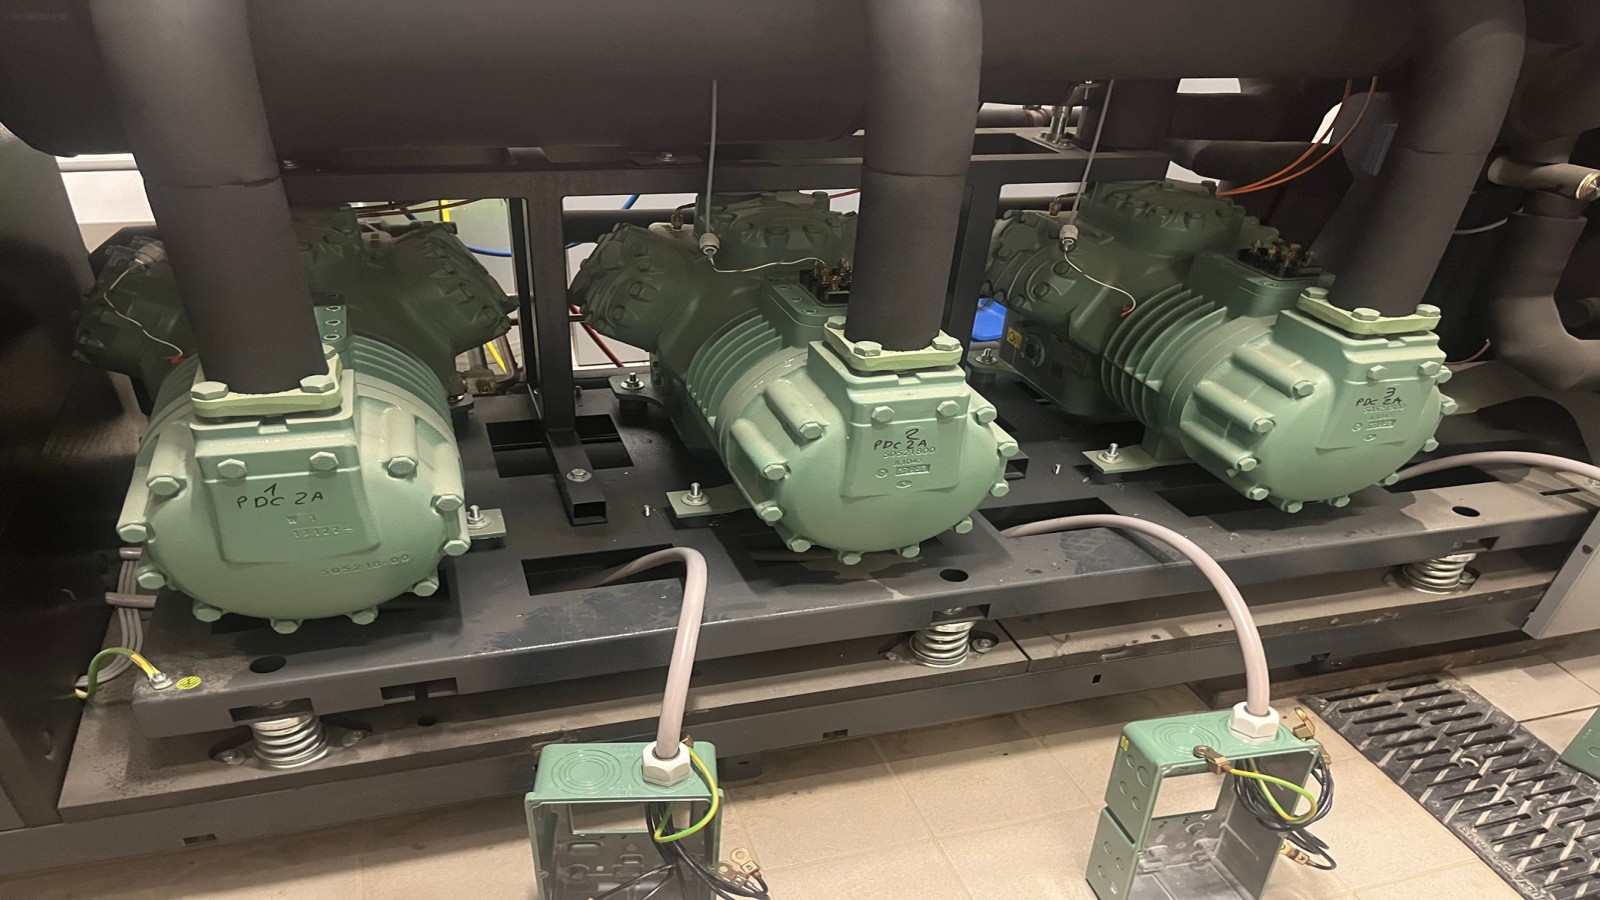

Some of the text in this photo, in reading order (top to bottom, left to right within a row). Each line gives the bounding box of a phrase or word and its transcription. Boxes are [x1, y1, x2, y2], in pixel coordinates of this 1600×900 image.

[1383, 387, 1396, 399] 3
[1355, 397, 1378, 406] PDC
[905, 428, 920, 440] 2
[874, 440, 901, 450] PDC
[264, 483, 277, 497] 1
[236, 495, 286, 509] PDC
